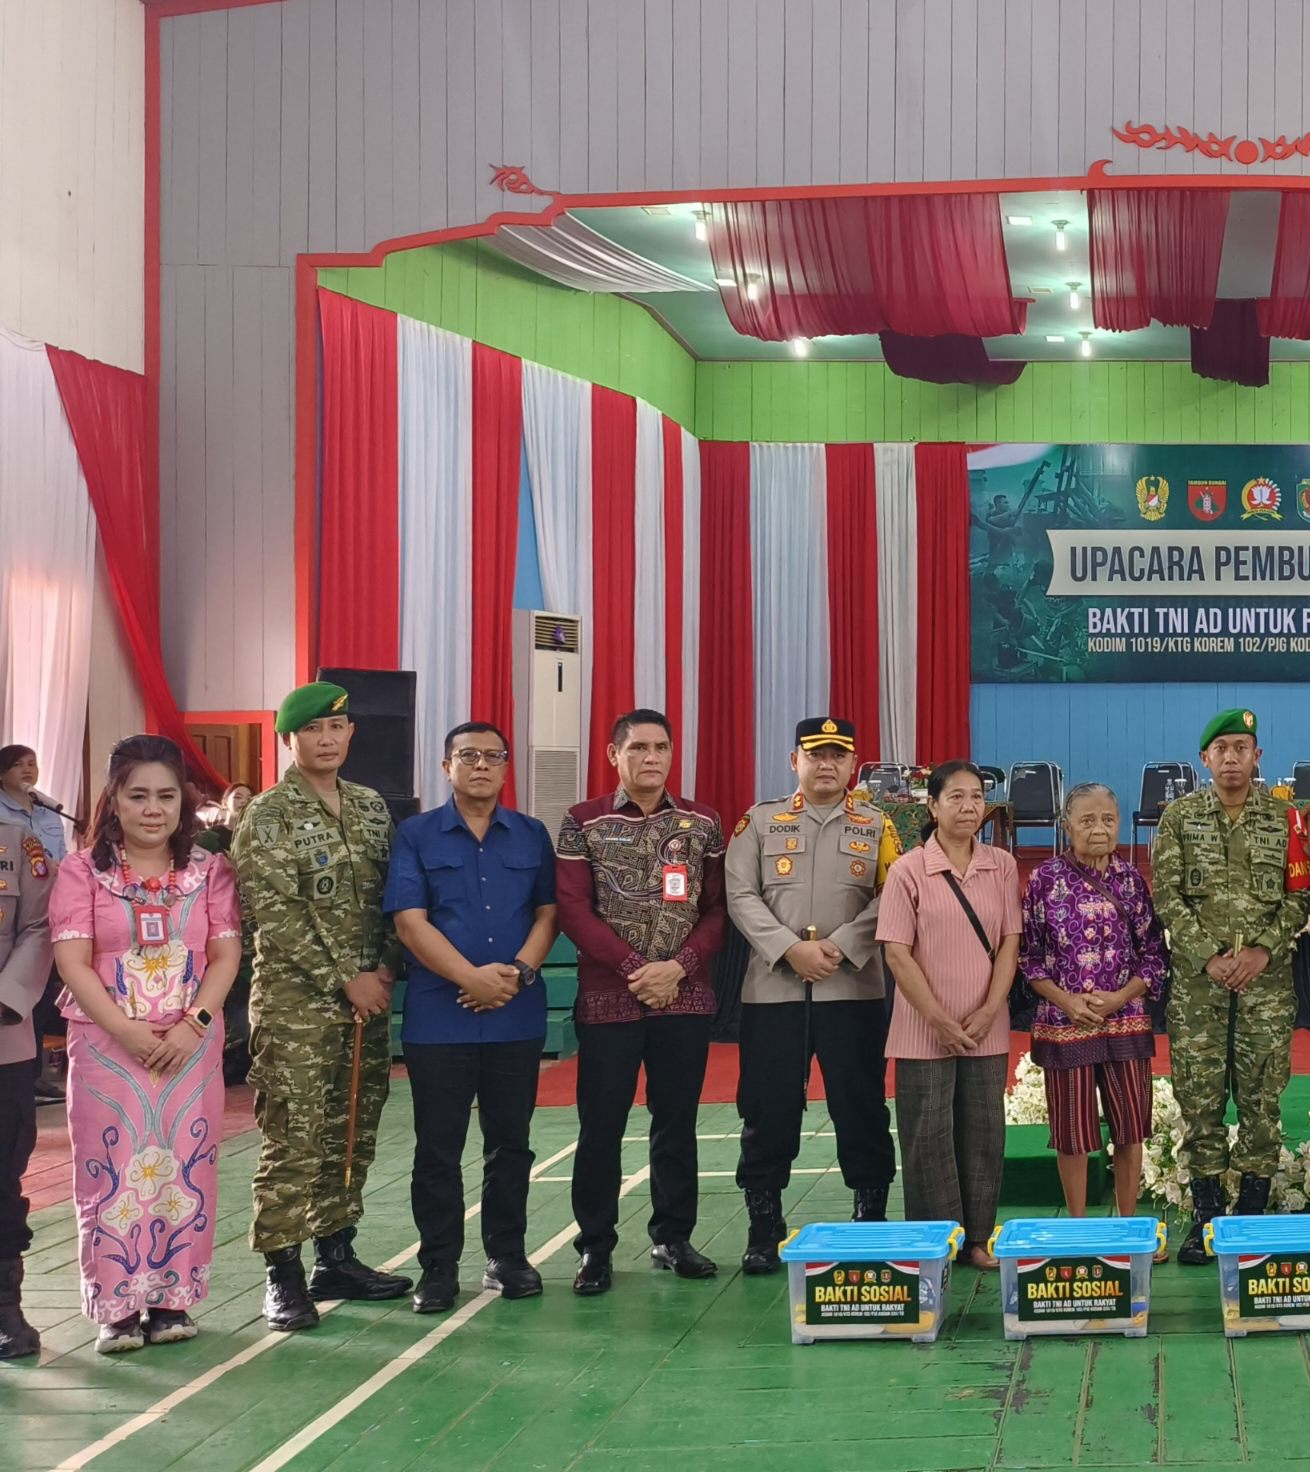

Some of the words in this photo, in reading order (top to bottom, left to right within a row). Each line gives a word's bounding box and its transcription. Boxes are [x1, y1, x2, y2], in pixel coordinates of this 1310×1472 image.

[1070, 546, 1205, 582] UPACARA
[1088, 607, 1149, 633] BAKTI
[1155, 607, 1189, 633] TNI
[1194, 607, 1222, 633] AD
[1228, 607, 1297, 634] UNTUK
[1088, 637, 1126, 652] KODIM
[1130, 637, 1190, 652] 1019/KTG
[1194, 637, 1235, 652] KOREM
[1238, 637, 1287, 652] 102/PJG
[769, 825, 801, 834] DODIK
[844, 826, 876, 838] POLRI
[294, 832, 334, 849] PUTRA
[1211, 834, 1218, 842] W
[1254, 836, 1270, 845] TNI
[1275, 838, 1287, 848] AD
[1027, 1282, 1070, 1298] BAKTI
[1073, 1281, 1123, 1297] SOSIAL
[1248, 1278, 1289, 1295] BAKTI
[815, 1286, 858, 1302] BAKTI
[861, 1285, 912, 1301] SOSIAL
[1254, 1296, 1271, 1304] BAKTI
[881, 1303, 905, 1311] RAKYAT
[1073, 1299, 1093, 1307] UNTUK
